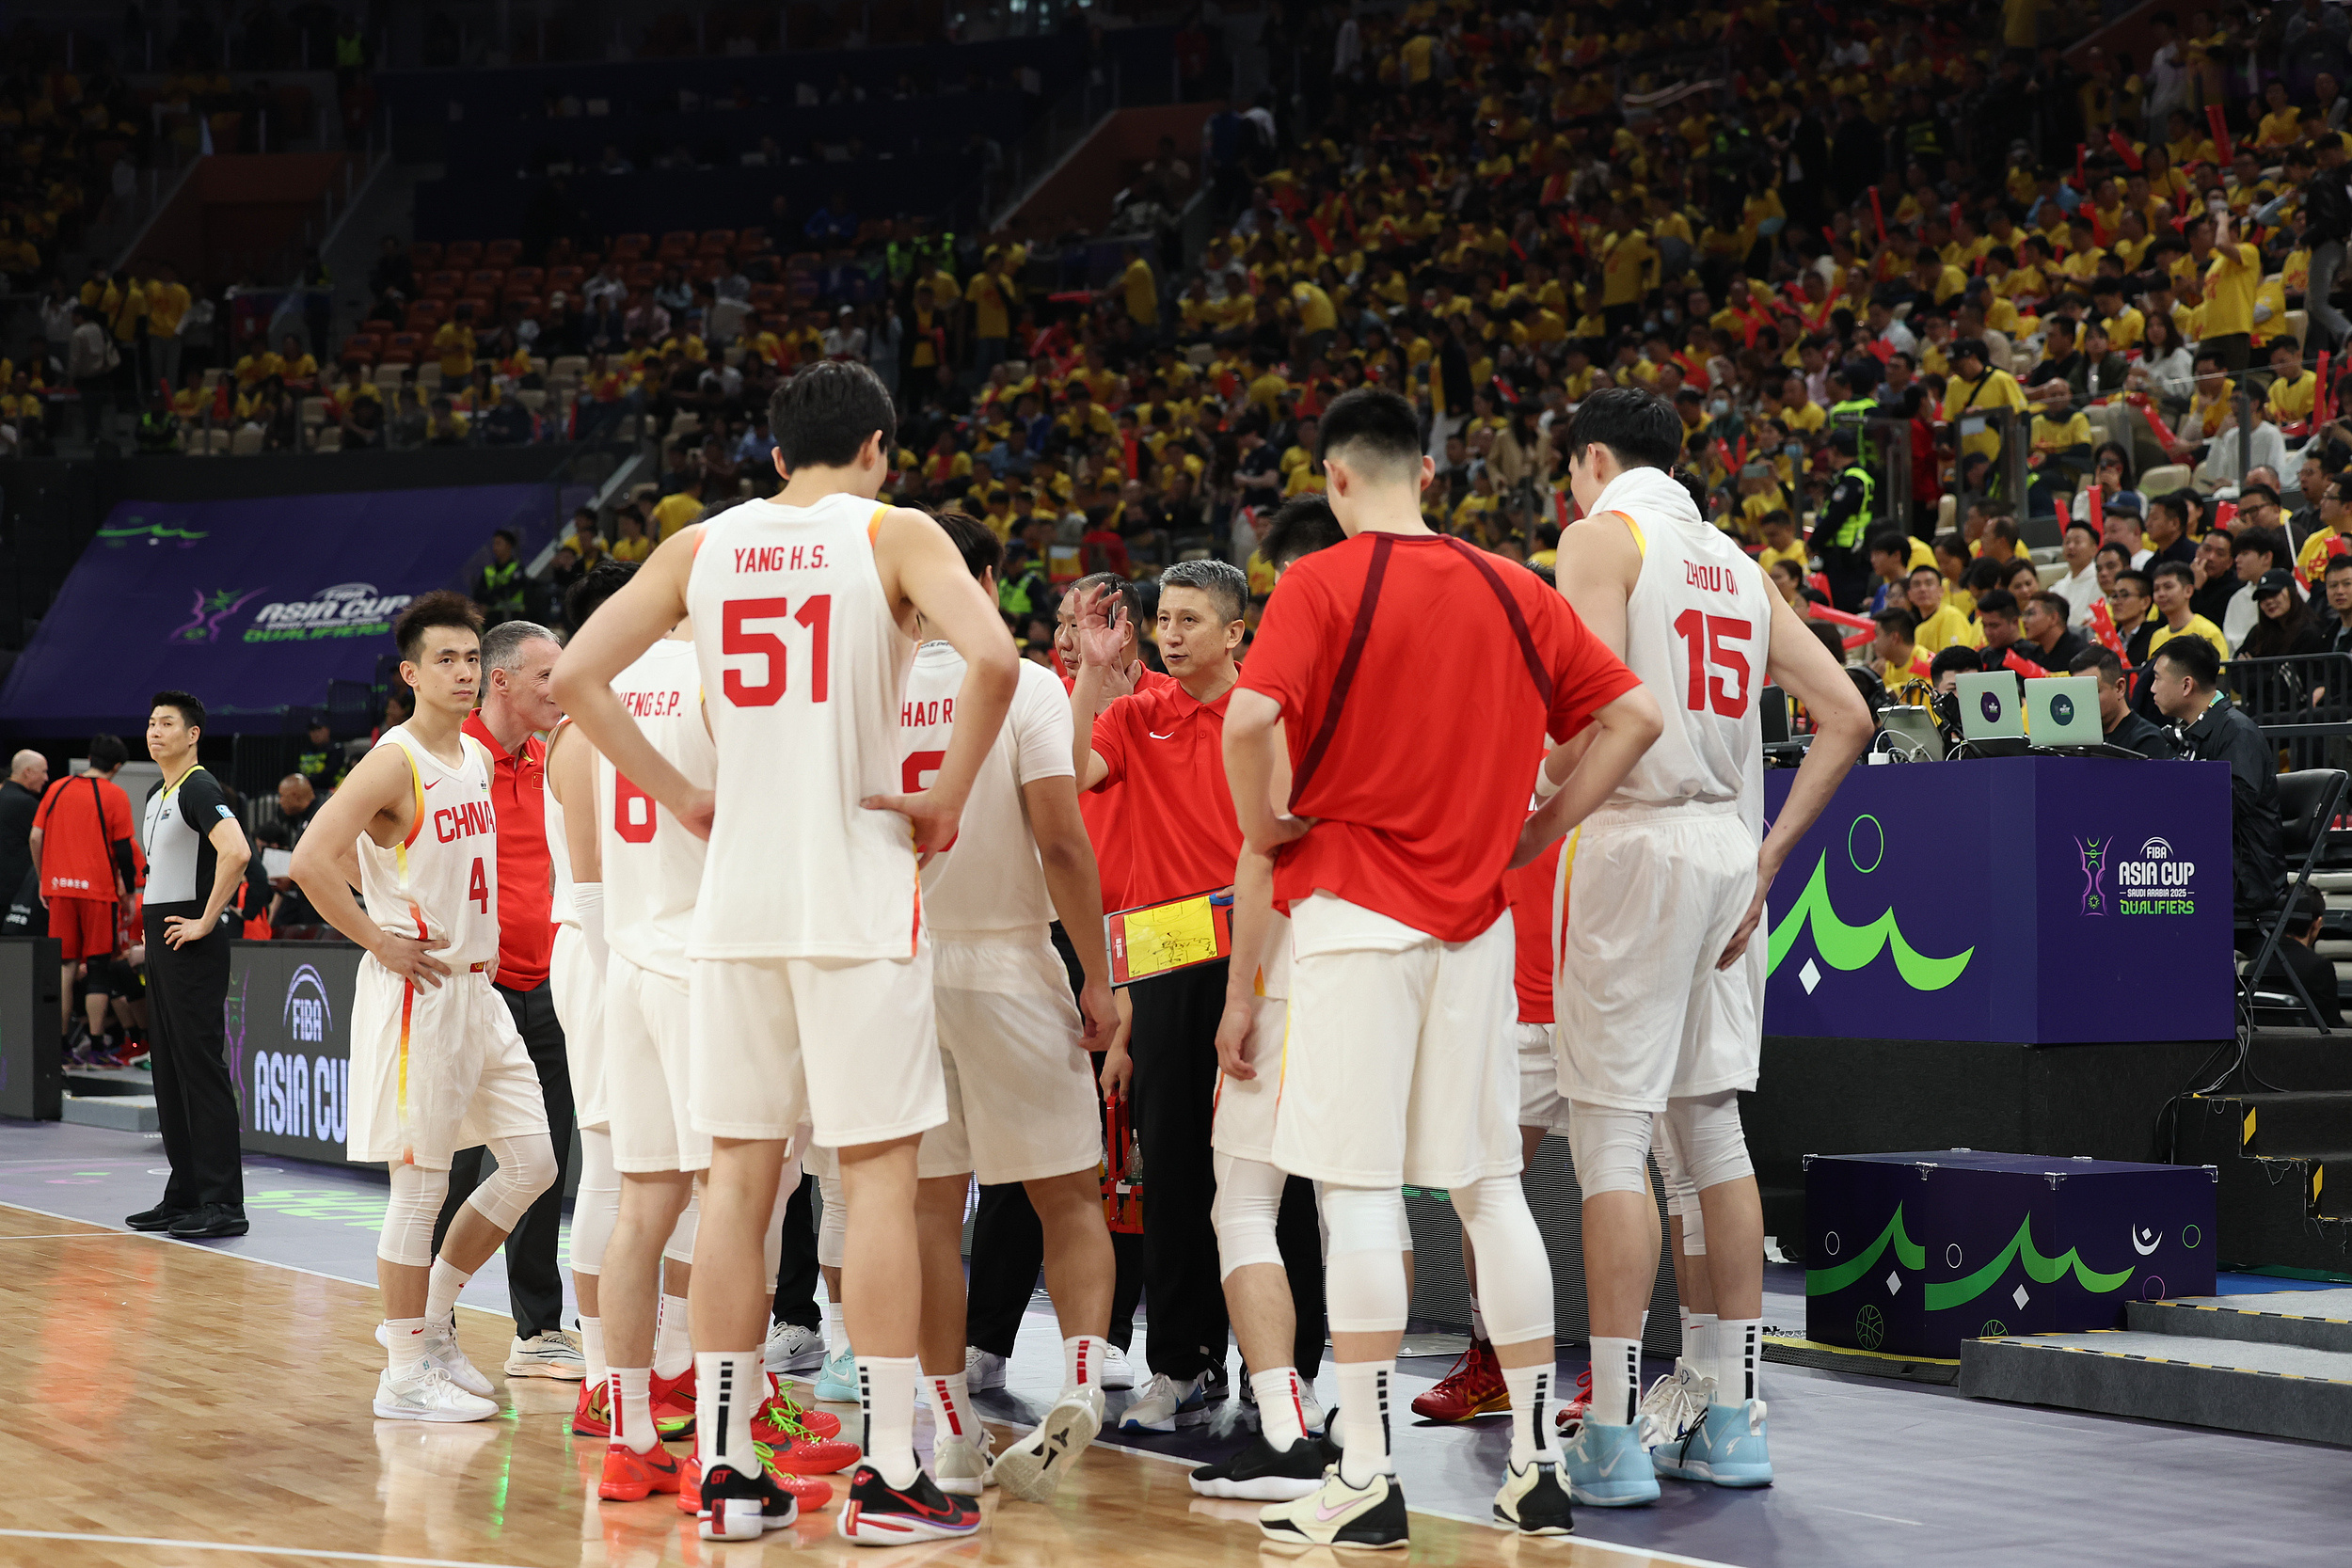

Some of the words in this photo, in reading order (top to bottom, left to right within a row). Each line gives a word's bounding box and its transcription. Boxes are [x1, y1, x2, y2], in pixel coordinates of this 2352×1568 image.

[735, 546, 785, 573] YANG
[790, 545, 829, 570] H.S.
[1683, 559, 1721, 593] ZHOU
[1724, 568, 1739, 595] QI
[255, 600, 340, 624] ASIA
[340, 594, 413, 618] CUP
[723, 594, 831, 707] 51
[1674, 609, 1752, 719] 15
[617, 691, 654, 717] ENG
[655, 690, 681, 717] S.P.
[900, 701, 938, 727] HAO
[434, 800, 496, 844] CHNA
[2146, 847, 2167, 859] FIBA
[469, 857, 488, 914] 4
[2119, 862, 2158, 885] ASIA
[2161, 862, 2195, 885] CUP
[2120, 899, 2195, 915] QUALIFIERS
[2127, 888, 2146, 897] SAUDI
[2146, 888, 2169, 897] ARABIA
[2169, 888, 2187, 897] 2025
[293, 999, 322, 1042] FIBA
[254, 1050, 310, 1138] ASIA
[314, 1055, 351, 1144] CU
